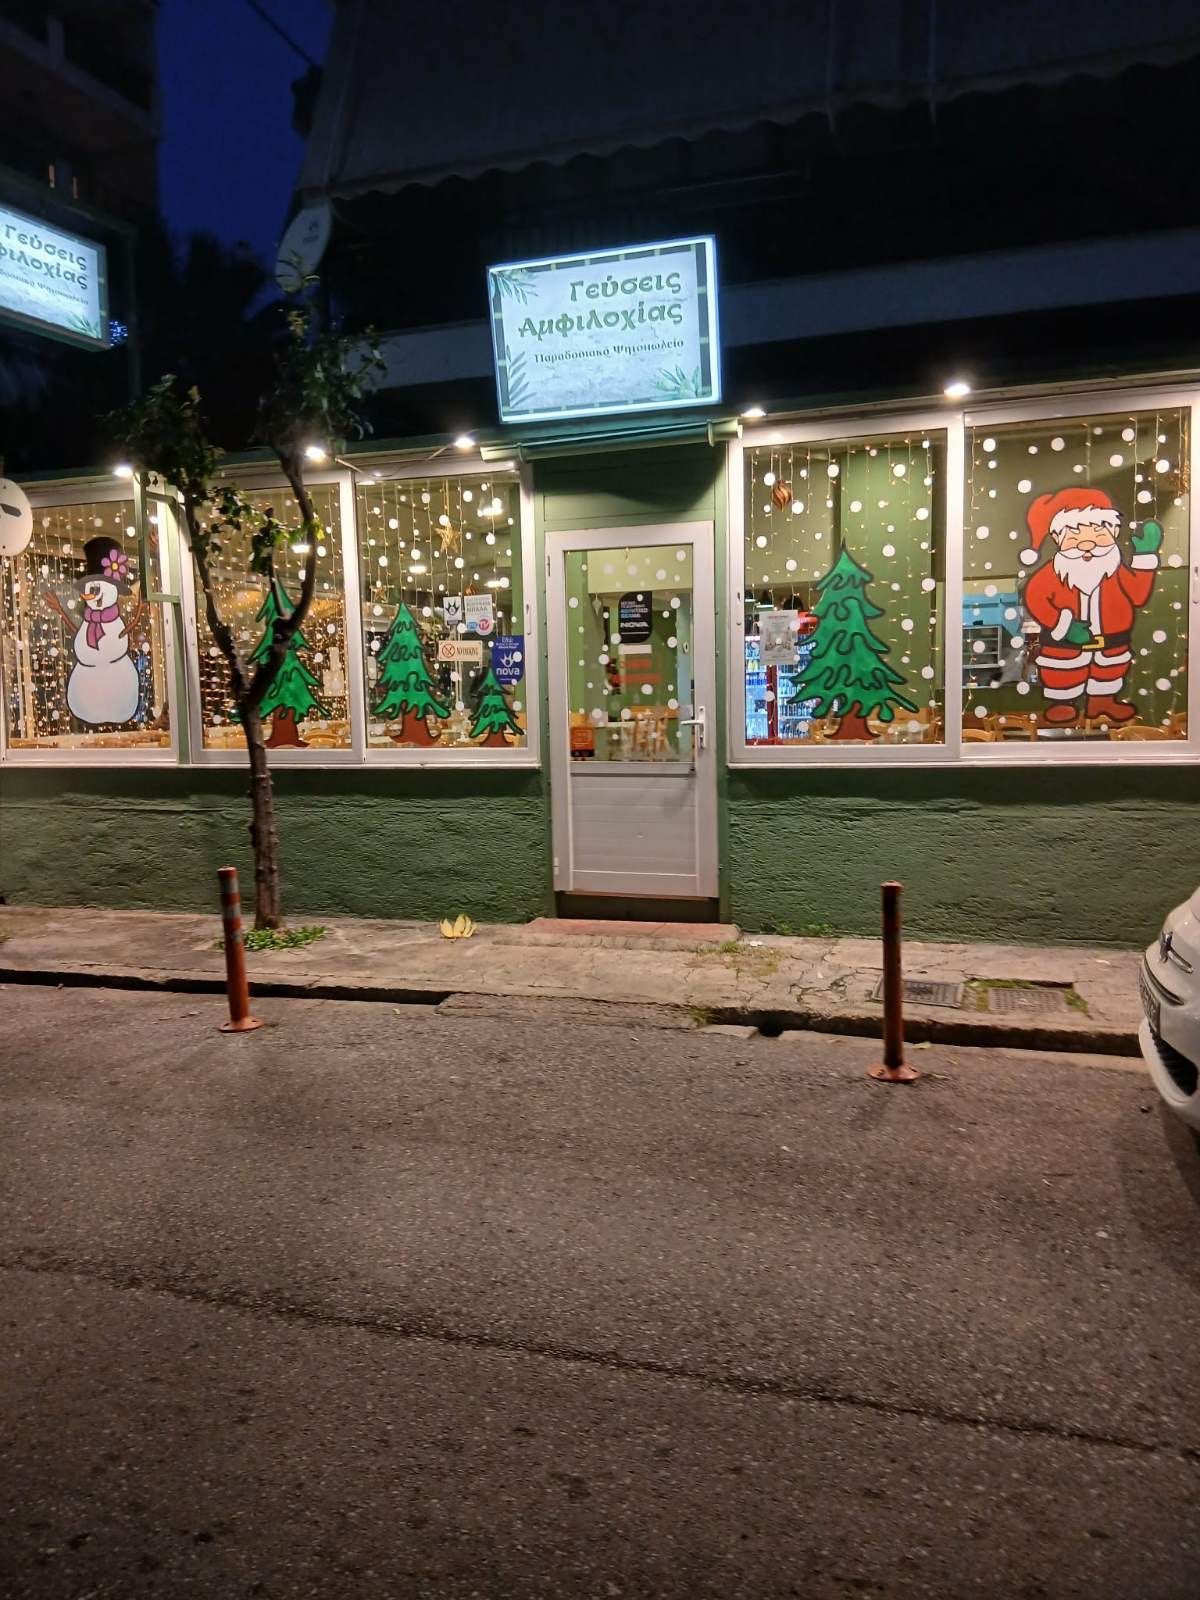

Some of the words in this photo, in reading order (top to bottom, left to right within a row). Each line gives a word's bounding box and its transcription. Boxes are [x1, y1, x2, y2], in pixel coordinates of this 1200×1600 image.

[4, 224, 88, 271] Γεύσεις
[570, 272, 682, 301] Γεύσεις
[518, 300, 683, 341] Αμφιλοχίας
[496, 667, 520, 676] nova
